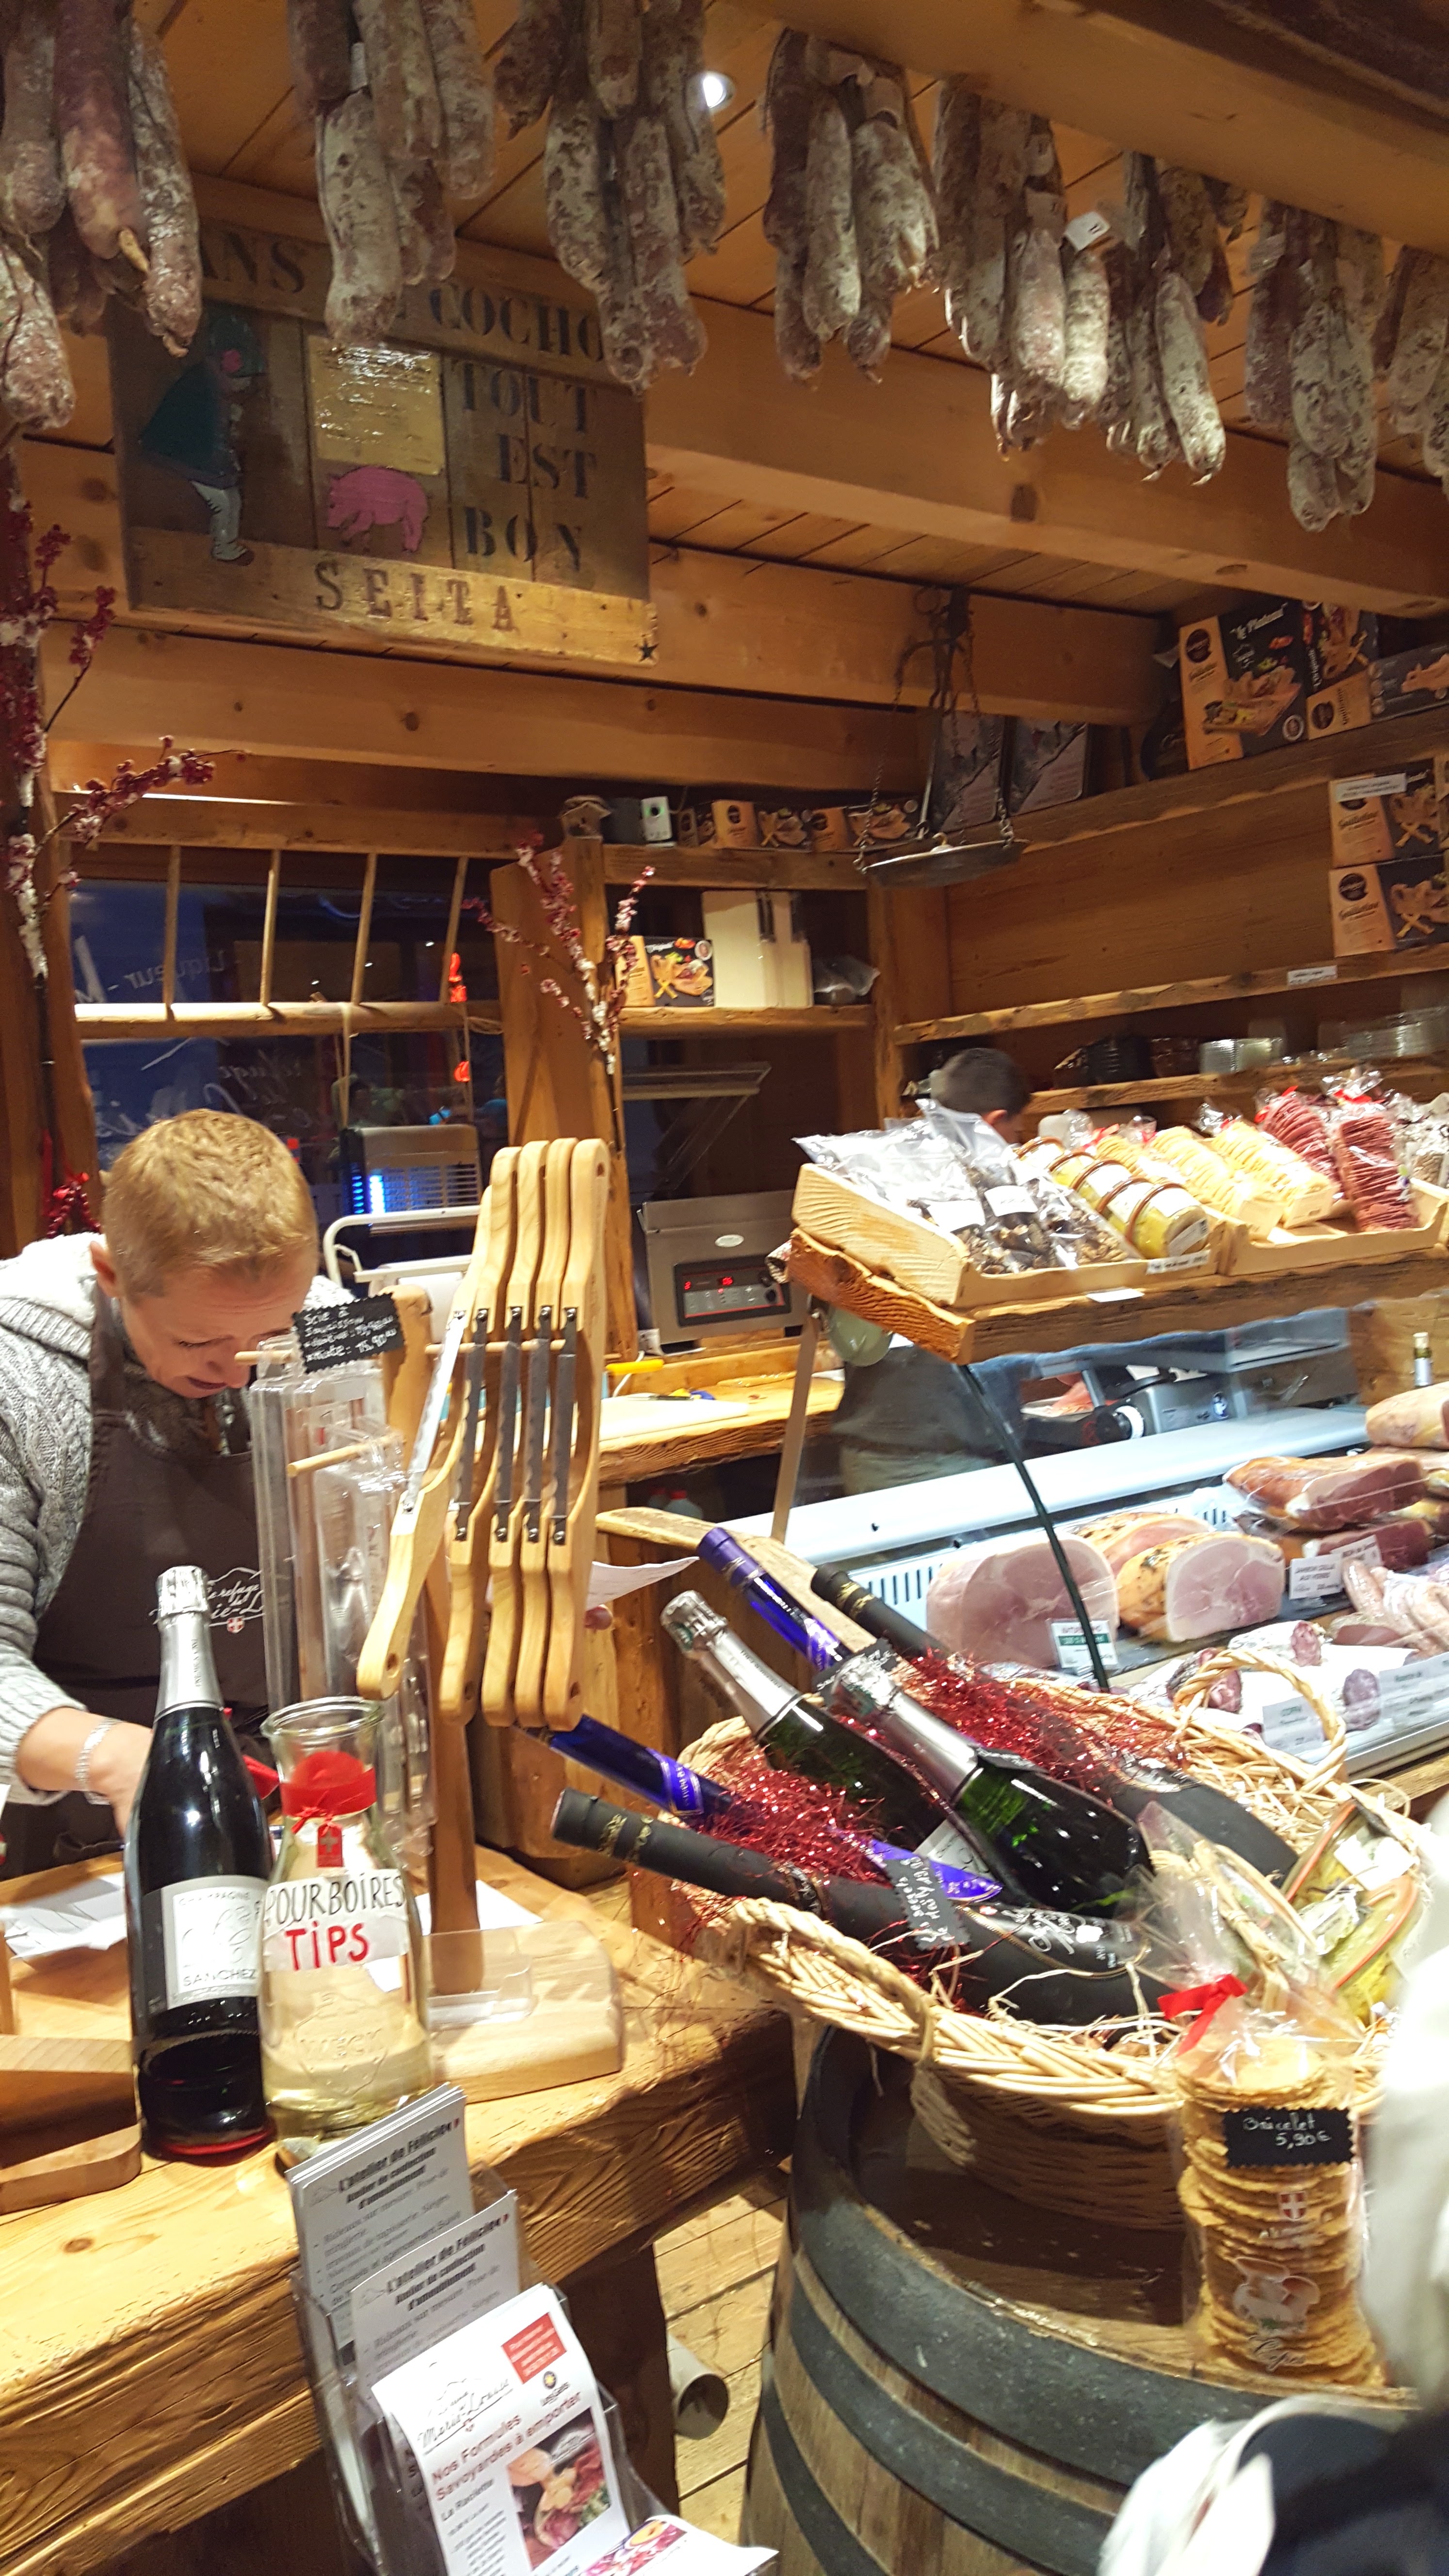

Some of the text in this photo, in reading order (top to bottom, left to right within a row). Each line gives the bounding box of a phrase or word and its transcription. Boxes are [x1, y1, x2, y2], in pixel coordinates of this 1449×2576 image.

[430, 285, 604, 362] COCHO
[450, 358, 597, 433] TOUT
[496, 433, 596, 499] EST
[462, 506, 582, 571] BON
[314, 560, 518, 633] SEITA
[183, 1968, 257, 1987] SANCHEZ
[1274, 2130, 1332, 2150] 5,90€
[432, 2459, 459, 2485] Nos
[461, 2414, 521, 2463] Formules
[436, 2442, 513, 2501] Savoyardes
